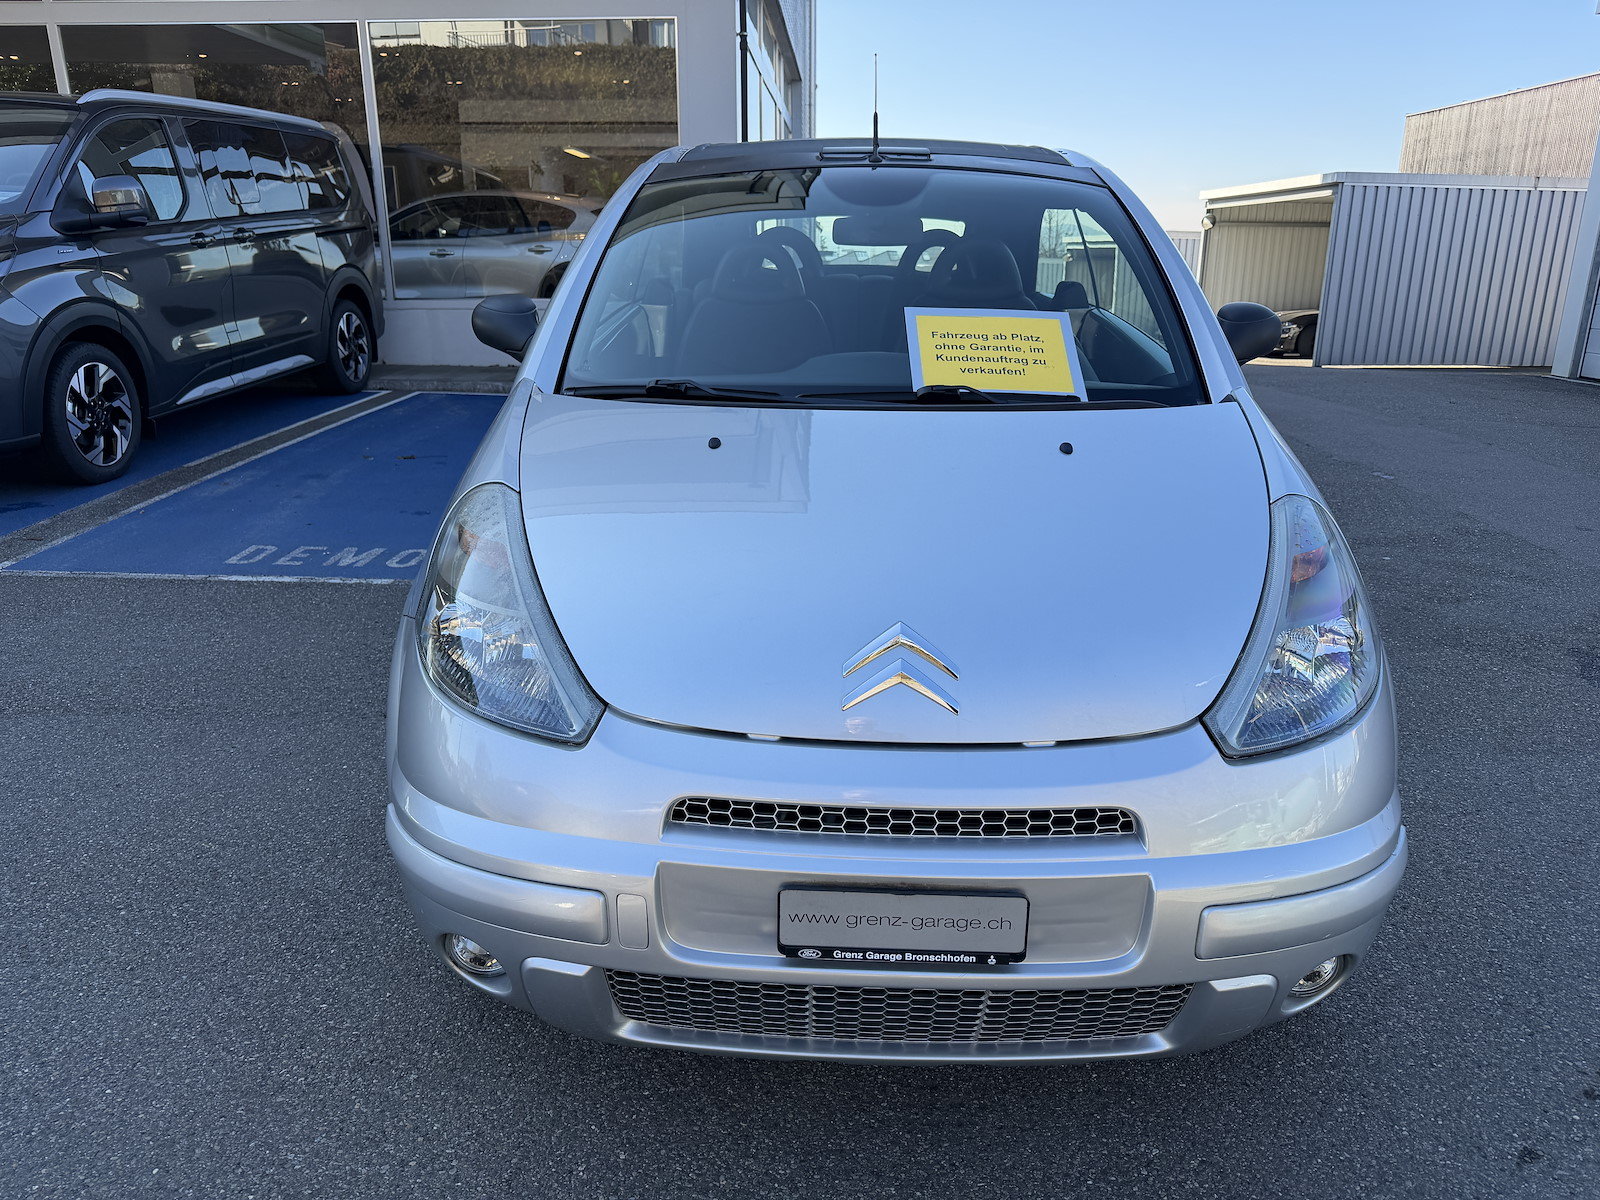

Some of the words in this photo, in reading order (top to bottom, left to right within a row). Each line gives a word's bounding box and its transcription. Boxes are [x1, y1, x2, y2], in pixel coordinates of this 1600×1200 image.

[931, 331, 989, 342] Fahrzeug
[992, 333, 1007, 341] ab
[1011, 333, 1045, 343] Platz,
[969, 343, 1026, 354] Garantie,
[1029, 345, 1044, 354] im
[935, 353, 1029, 366] Kundenauftrag
[1032, 358, 1047, 366] zu
[959, 366, 1026, 376] verkaufen!
[225, 544, 427, 568] DEMO
[833, 950, 863, 959] Grenz
[865, 951, 902, 962] Garage
[905, 952, 976, 963] Bronschhofen
